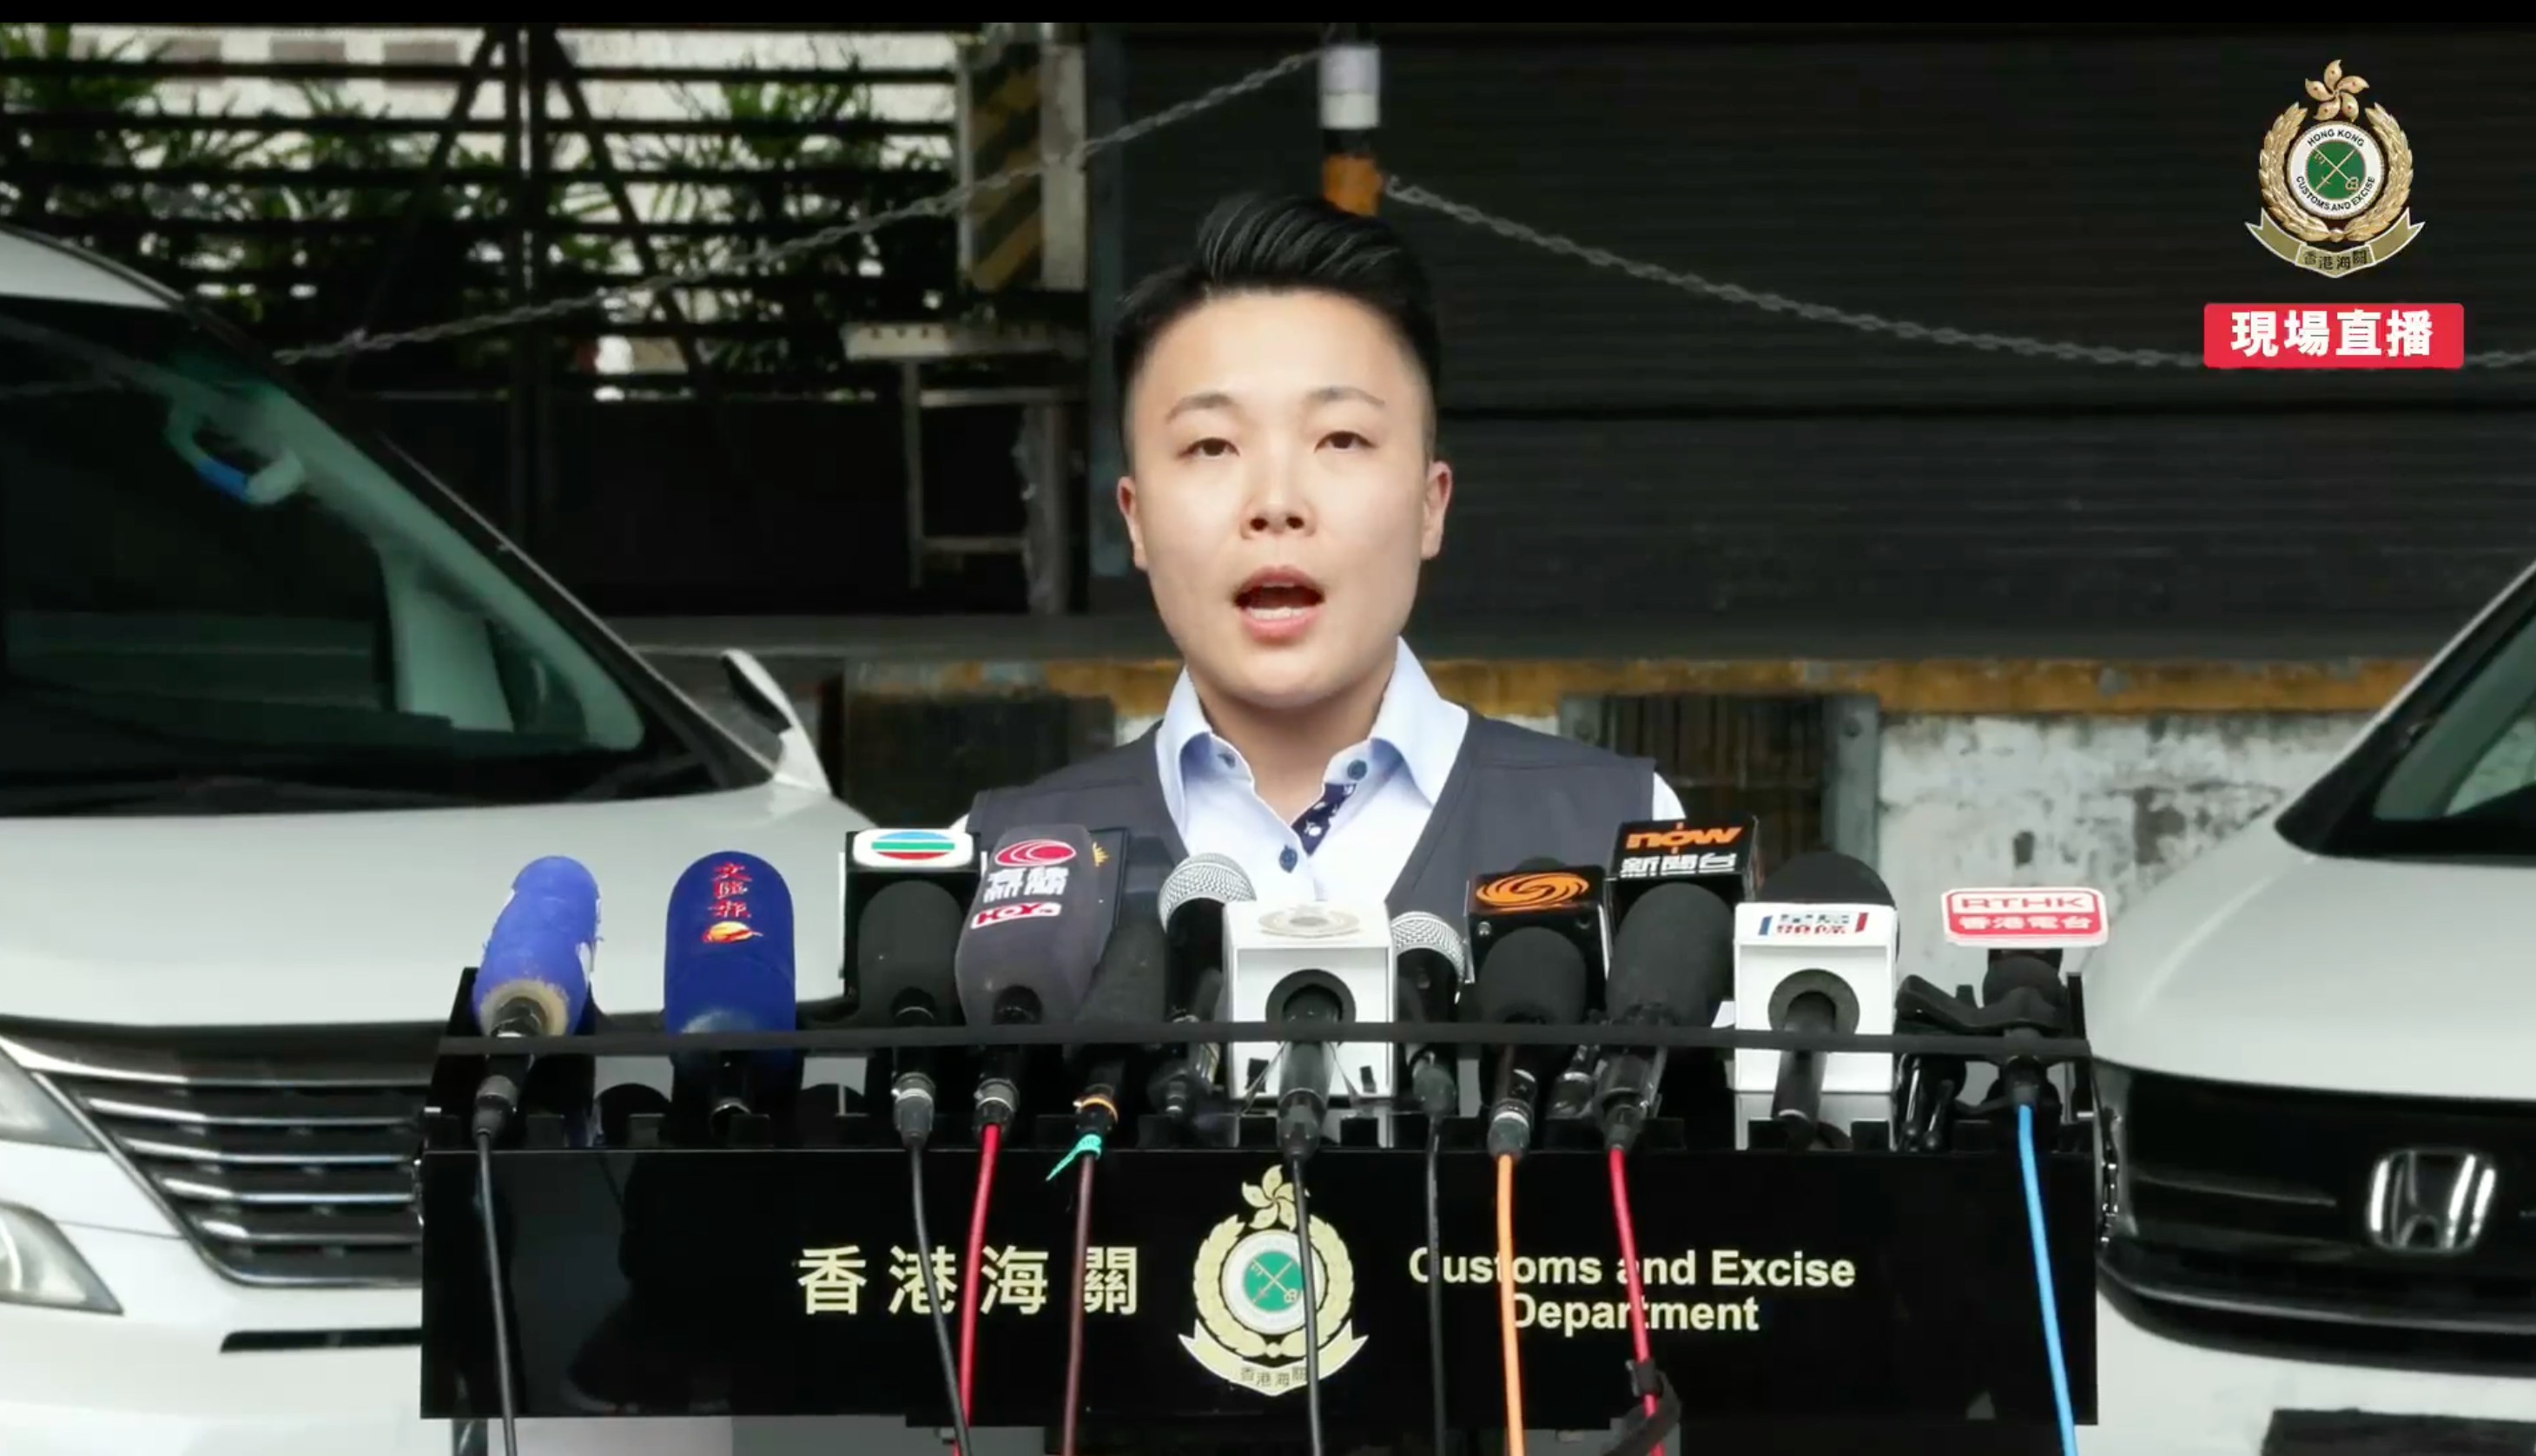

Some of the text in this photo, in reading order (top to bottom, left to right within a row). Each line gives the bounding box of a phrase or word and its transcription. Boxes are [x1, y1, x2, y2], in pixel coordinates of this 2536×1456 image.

[1961, 897, 2084, 908] RTHK
[1958, 915, 2092, 931] 香港電台
[796, 1244, 1139, 1315] 香港海關
[1711, 1250, 1856, 1287] Excise
